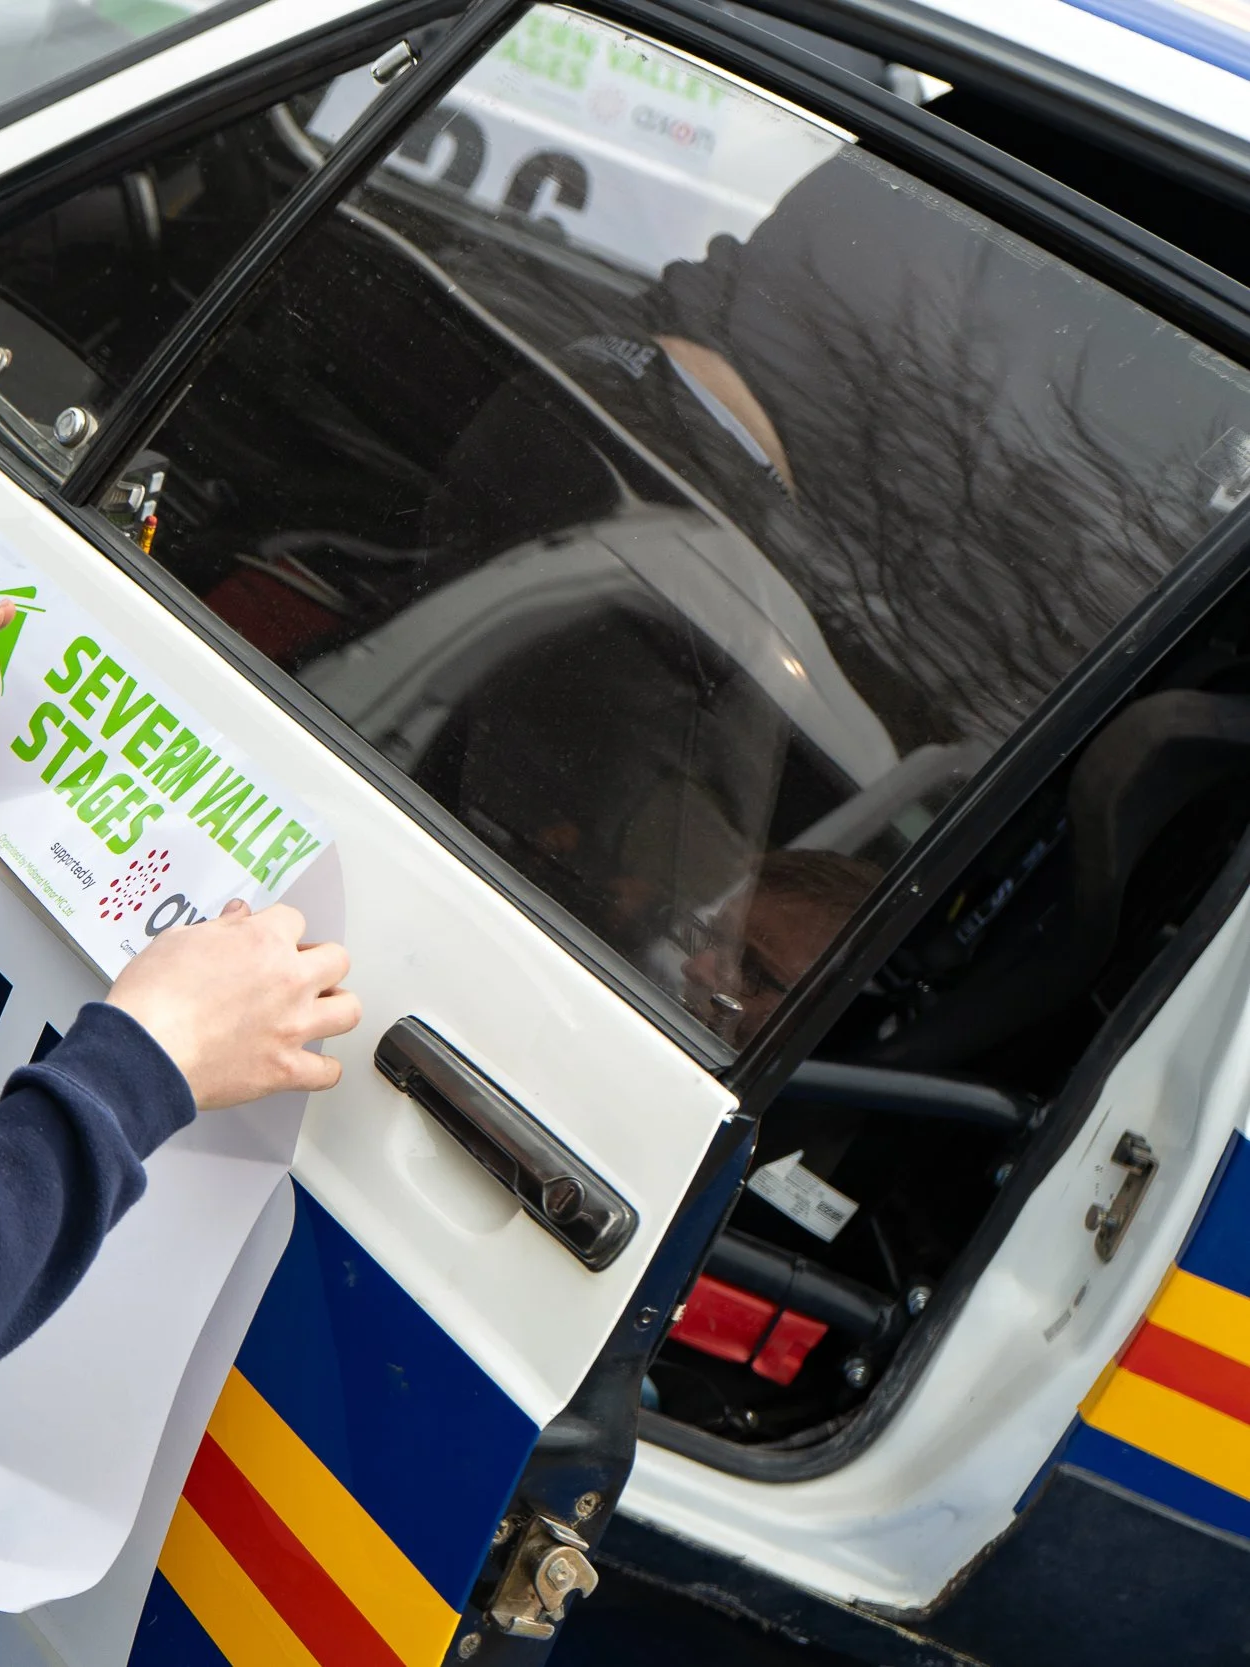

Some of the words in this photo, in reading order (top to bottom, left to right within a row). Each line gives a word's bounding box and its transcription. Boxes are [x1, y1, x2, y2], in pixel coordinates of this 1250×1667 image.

[9, 701, 165, 855] STAGES
[43, 635, 222, 803] SEVERN
[187, 765, 321, 893] VALLEY
[50, 842, 91, 880] supported
[81, 872, 96, 890] by
[61, 904, 76, 918] Ltd
